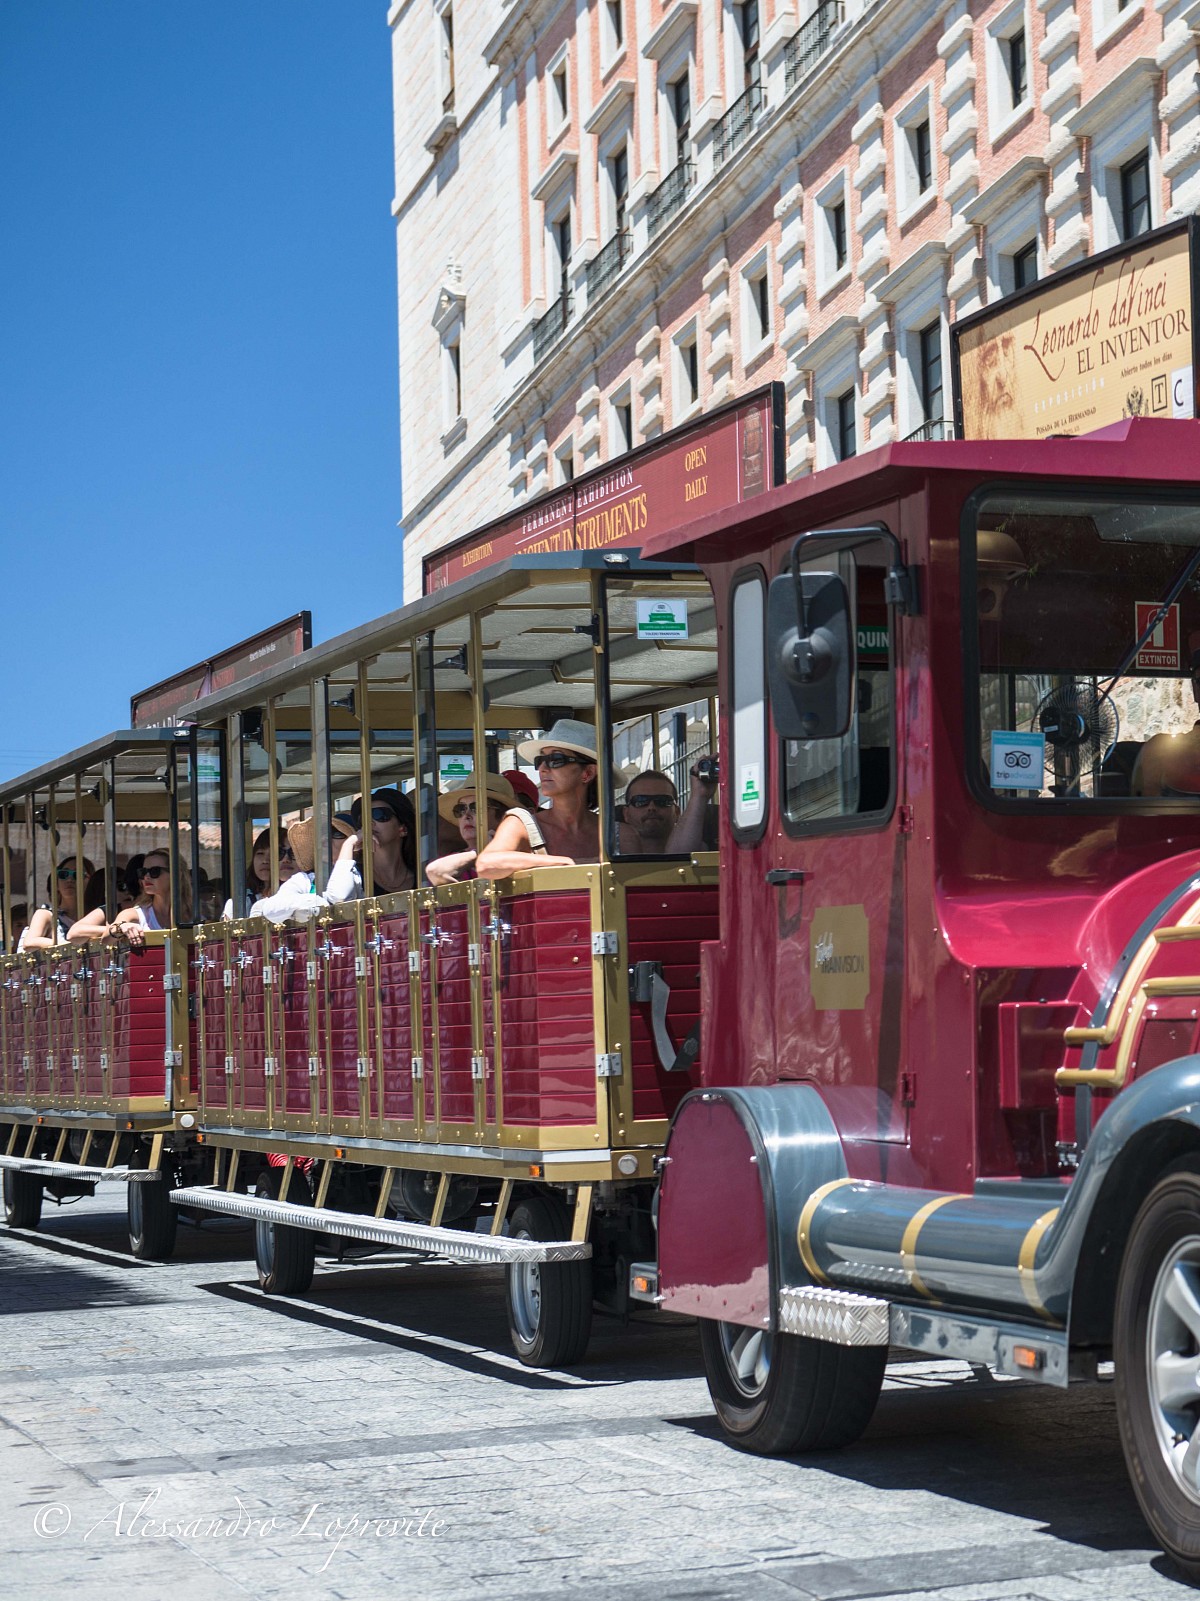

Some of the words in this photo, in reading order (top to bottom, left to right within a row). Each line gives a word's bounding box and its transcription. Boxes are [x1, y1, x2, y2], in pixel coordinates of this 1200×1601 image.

[1023, 267, 1105, 382] Leonardo
[1077, 346, 1095, 375] EL
[1100, 308, 1190, 366] INVENTOR
[1121, 366, 1139, 379] Abierto
[1139, 360, 1153, 371] todos
[1153, 356, 1161, 366] los
[1155, 382, 1164, 404] T
[1174, 378, 1184, 407] C
[685, 445, 707, 472] OPEN
[522, 495, 574, 535] PERMANENT
[577, 466, 634, 509] EXHIBITION
[685, 475, 708, 502] DAILY
[563, 493, 648, 551] INSTRUMENTS
[462, 541, 494, 568] EXHIBITION
[1139, 655, 1177, 665] EXTINTOR
